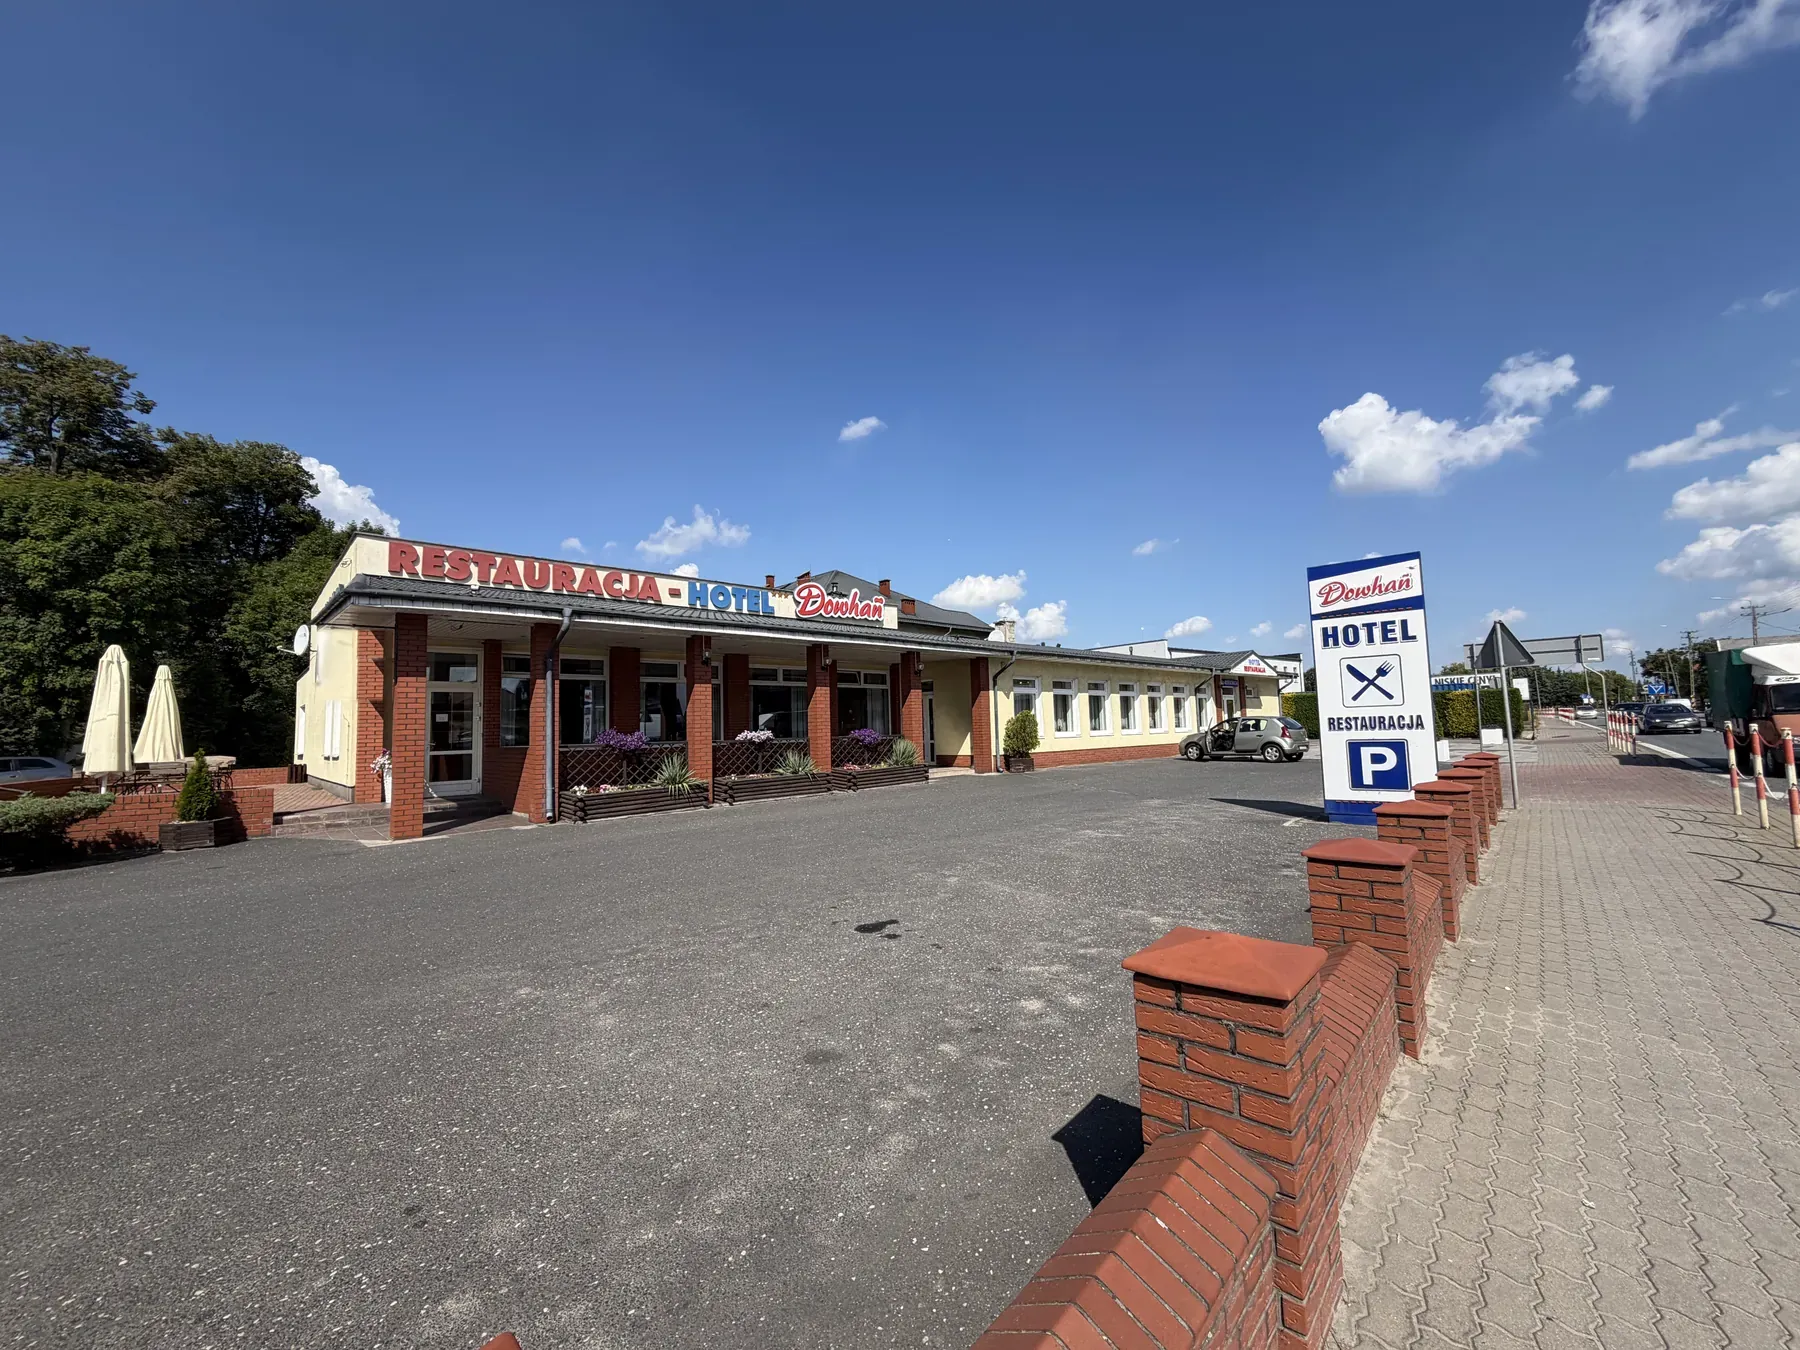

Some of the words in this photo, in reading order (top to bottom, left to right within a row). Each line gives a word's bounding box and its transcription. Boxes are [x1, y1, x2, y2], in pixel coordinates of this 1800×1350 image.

[389, 541, 662, 602] RESTAURACJA
[688, 581, 775, 615] HOTEL
[1322, 619, 1418, 649] HOTEL
[1328, 713, 1425, 732] RESTAURACJA
[1360, 746, 1398, 786] P
